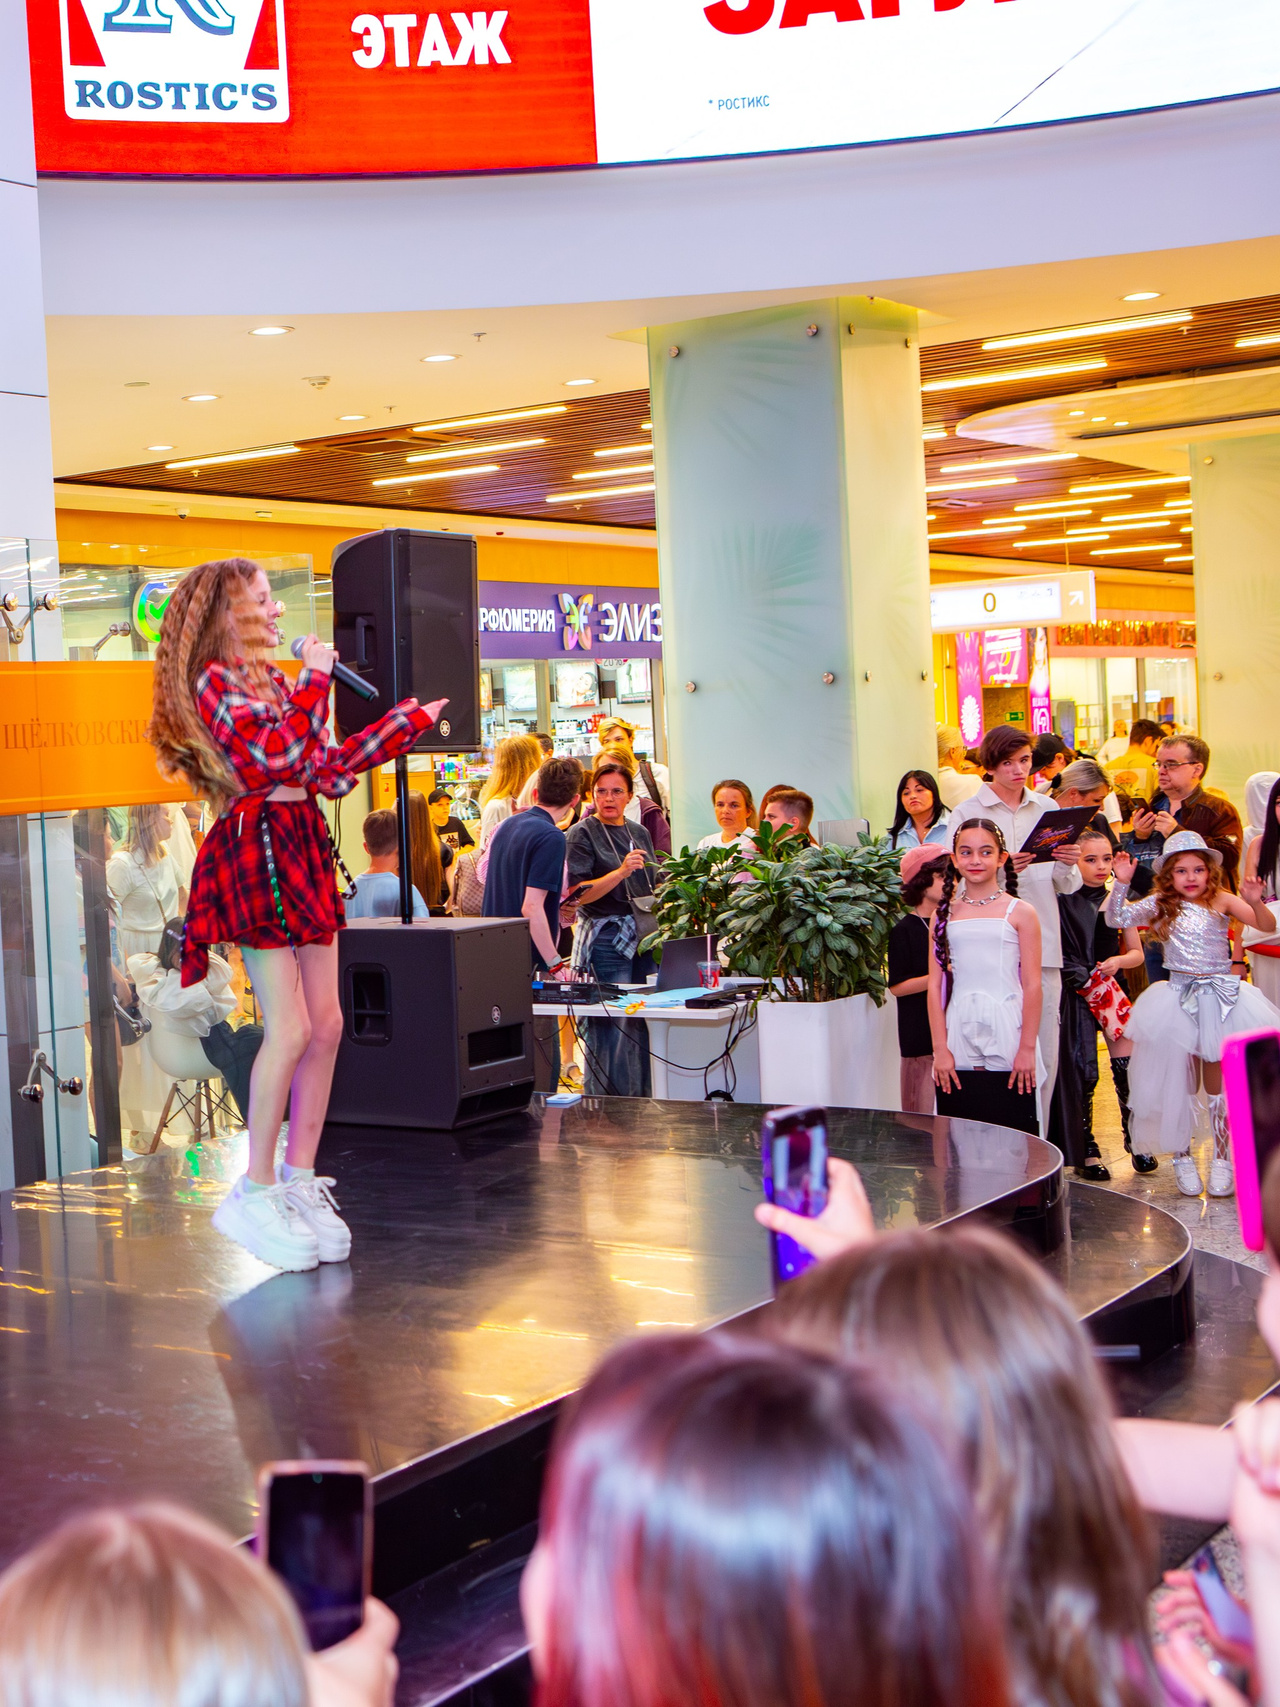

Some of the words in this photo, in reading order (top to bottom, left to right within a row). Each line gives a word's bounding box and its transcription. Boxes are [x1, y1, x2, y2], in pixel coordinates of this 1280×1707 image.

[351, 11, 512, 68] ЭТАЖ
[75, 80, 278, 111] ROSTIC'S
[718, 95, 770, 111] РОСТИКС
[479, 607, 556, 632] РФЮМЕРИЯ
